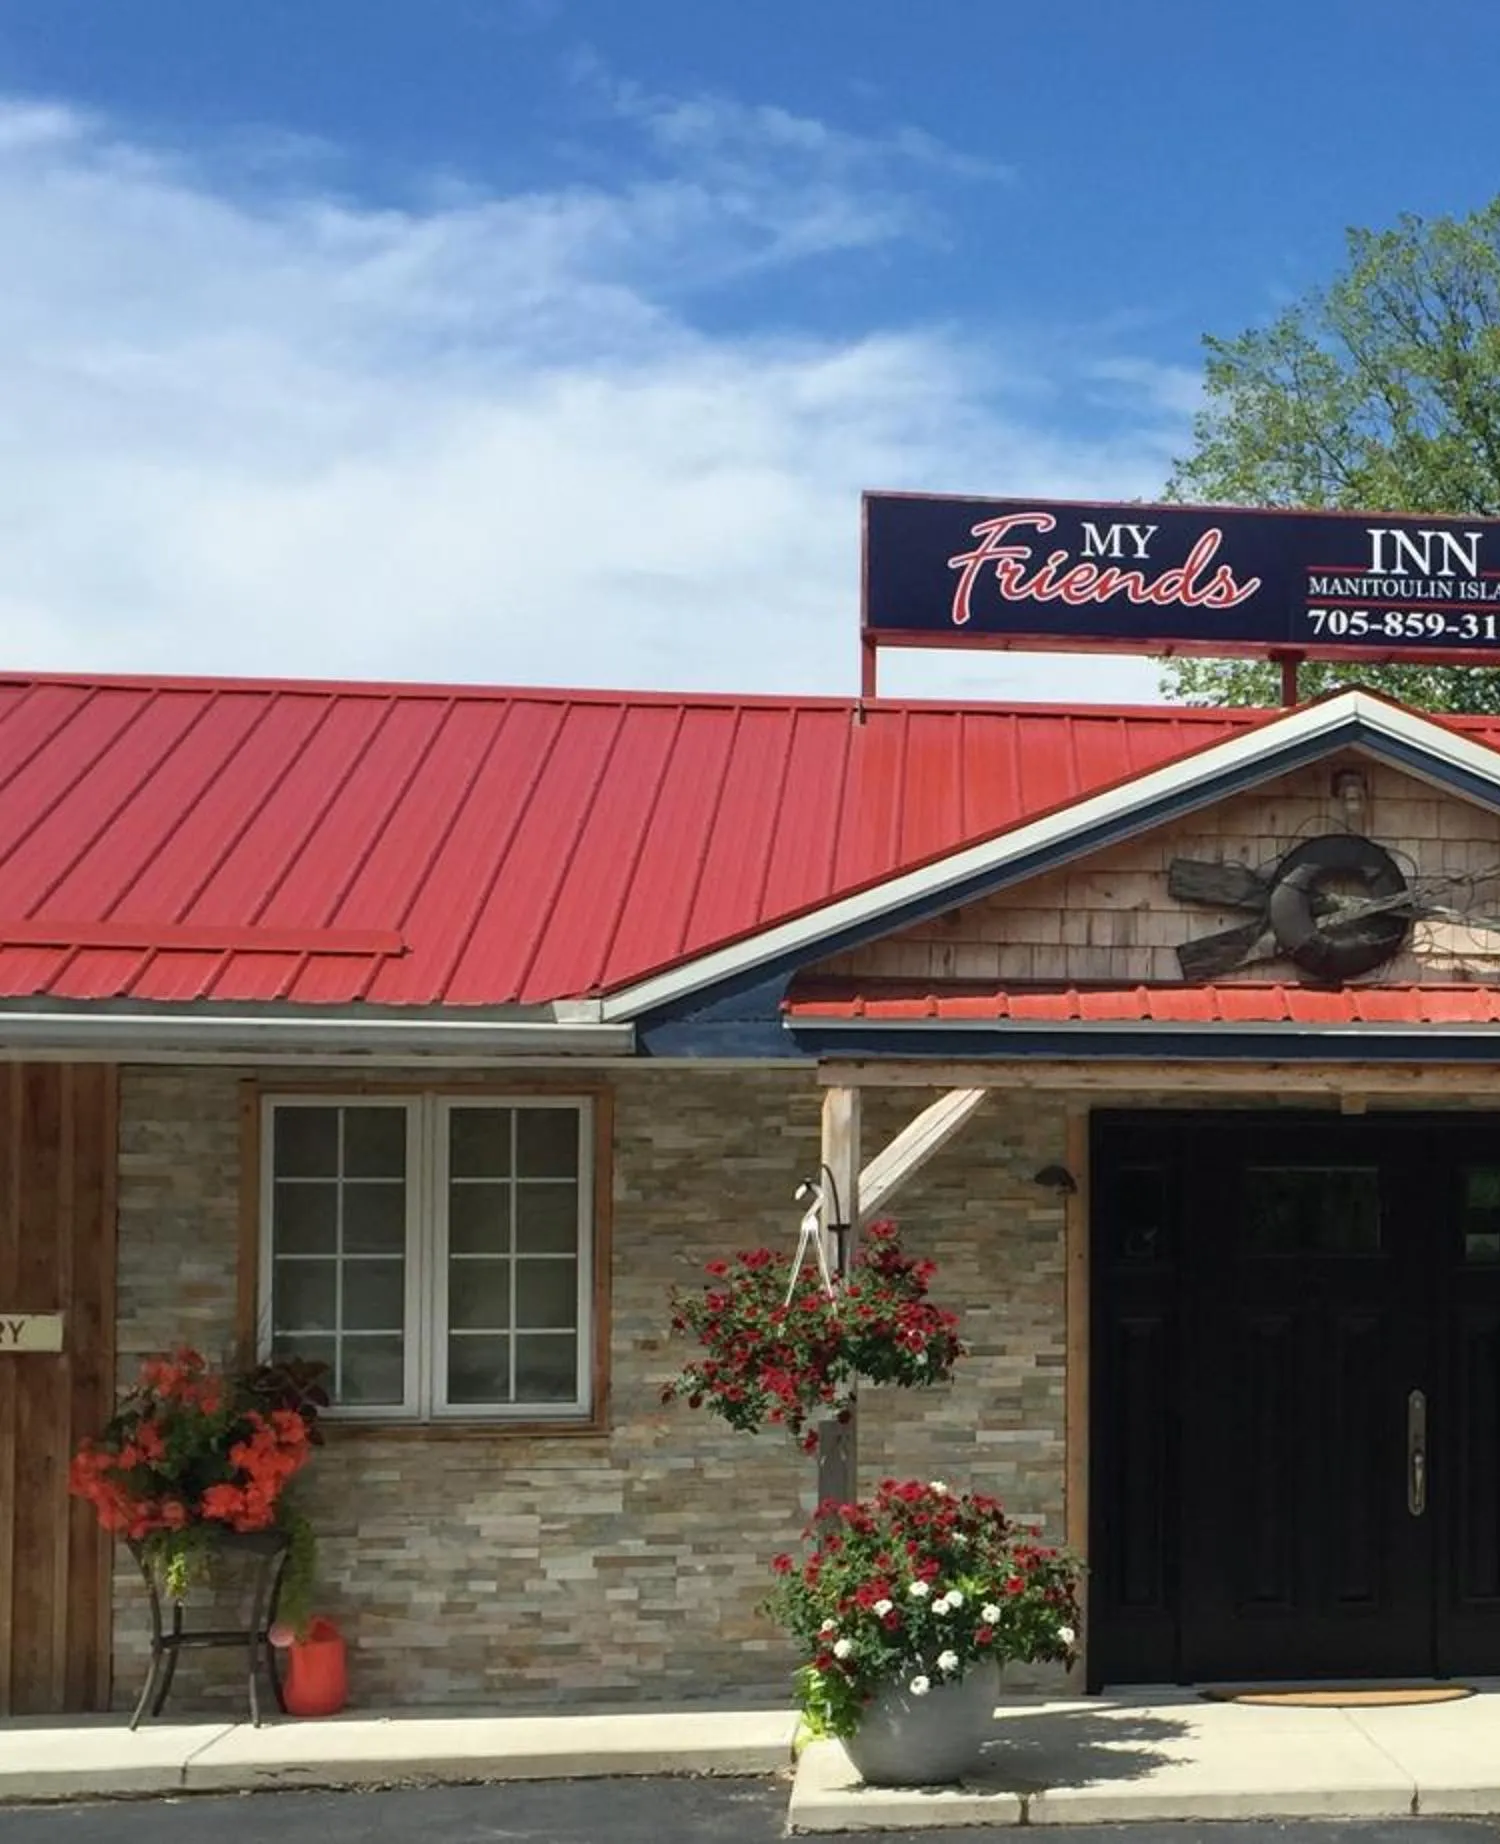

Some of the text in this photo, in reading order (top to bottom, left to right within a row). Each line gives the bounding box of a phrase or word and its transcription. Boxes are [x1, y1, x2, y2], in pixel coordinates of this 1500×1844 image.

[1080, 522, 1159, 559] MY
[1366, 528, 1484, 577] INN
[947, 511, 1262, 625] Friends
[1308, 576, 1454, 600] MANITOULIN
